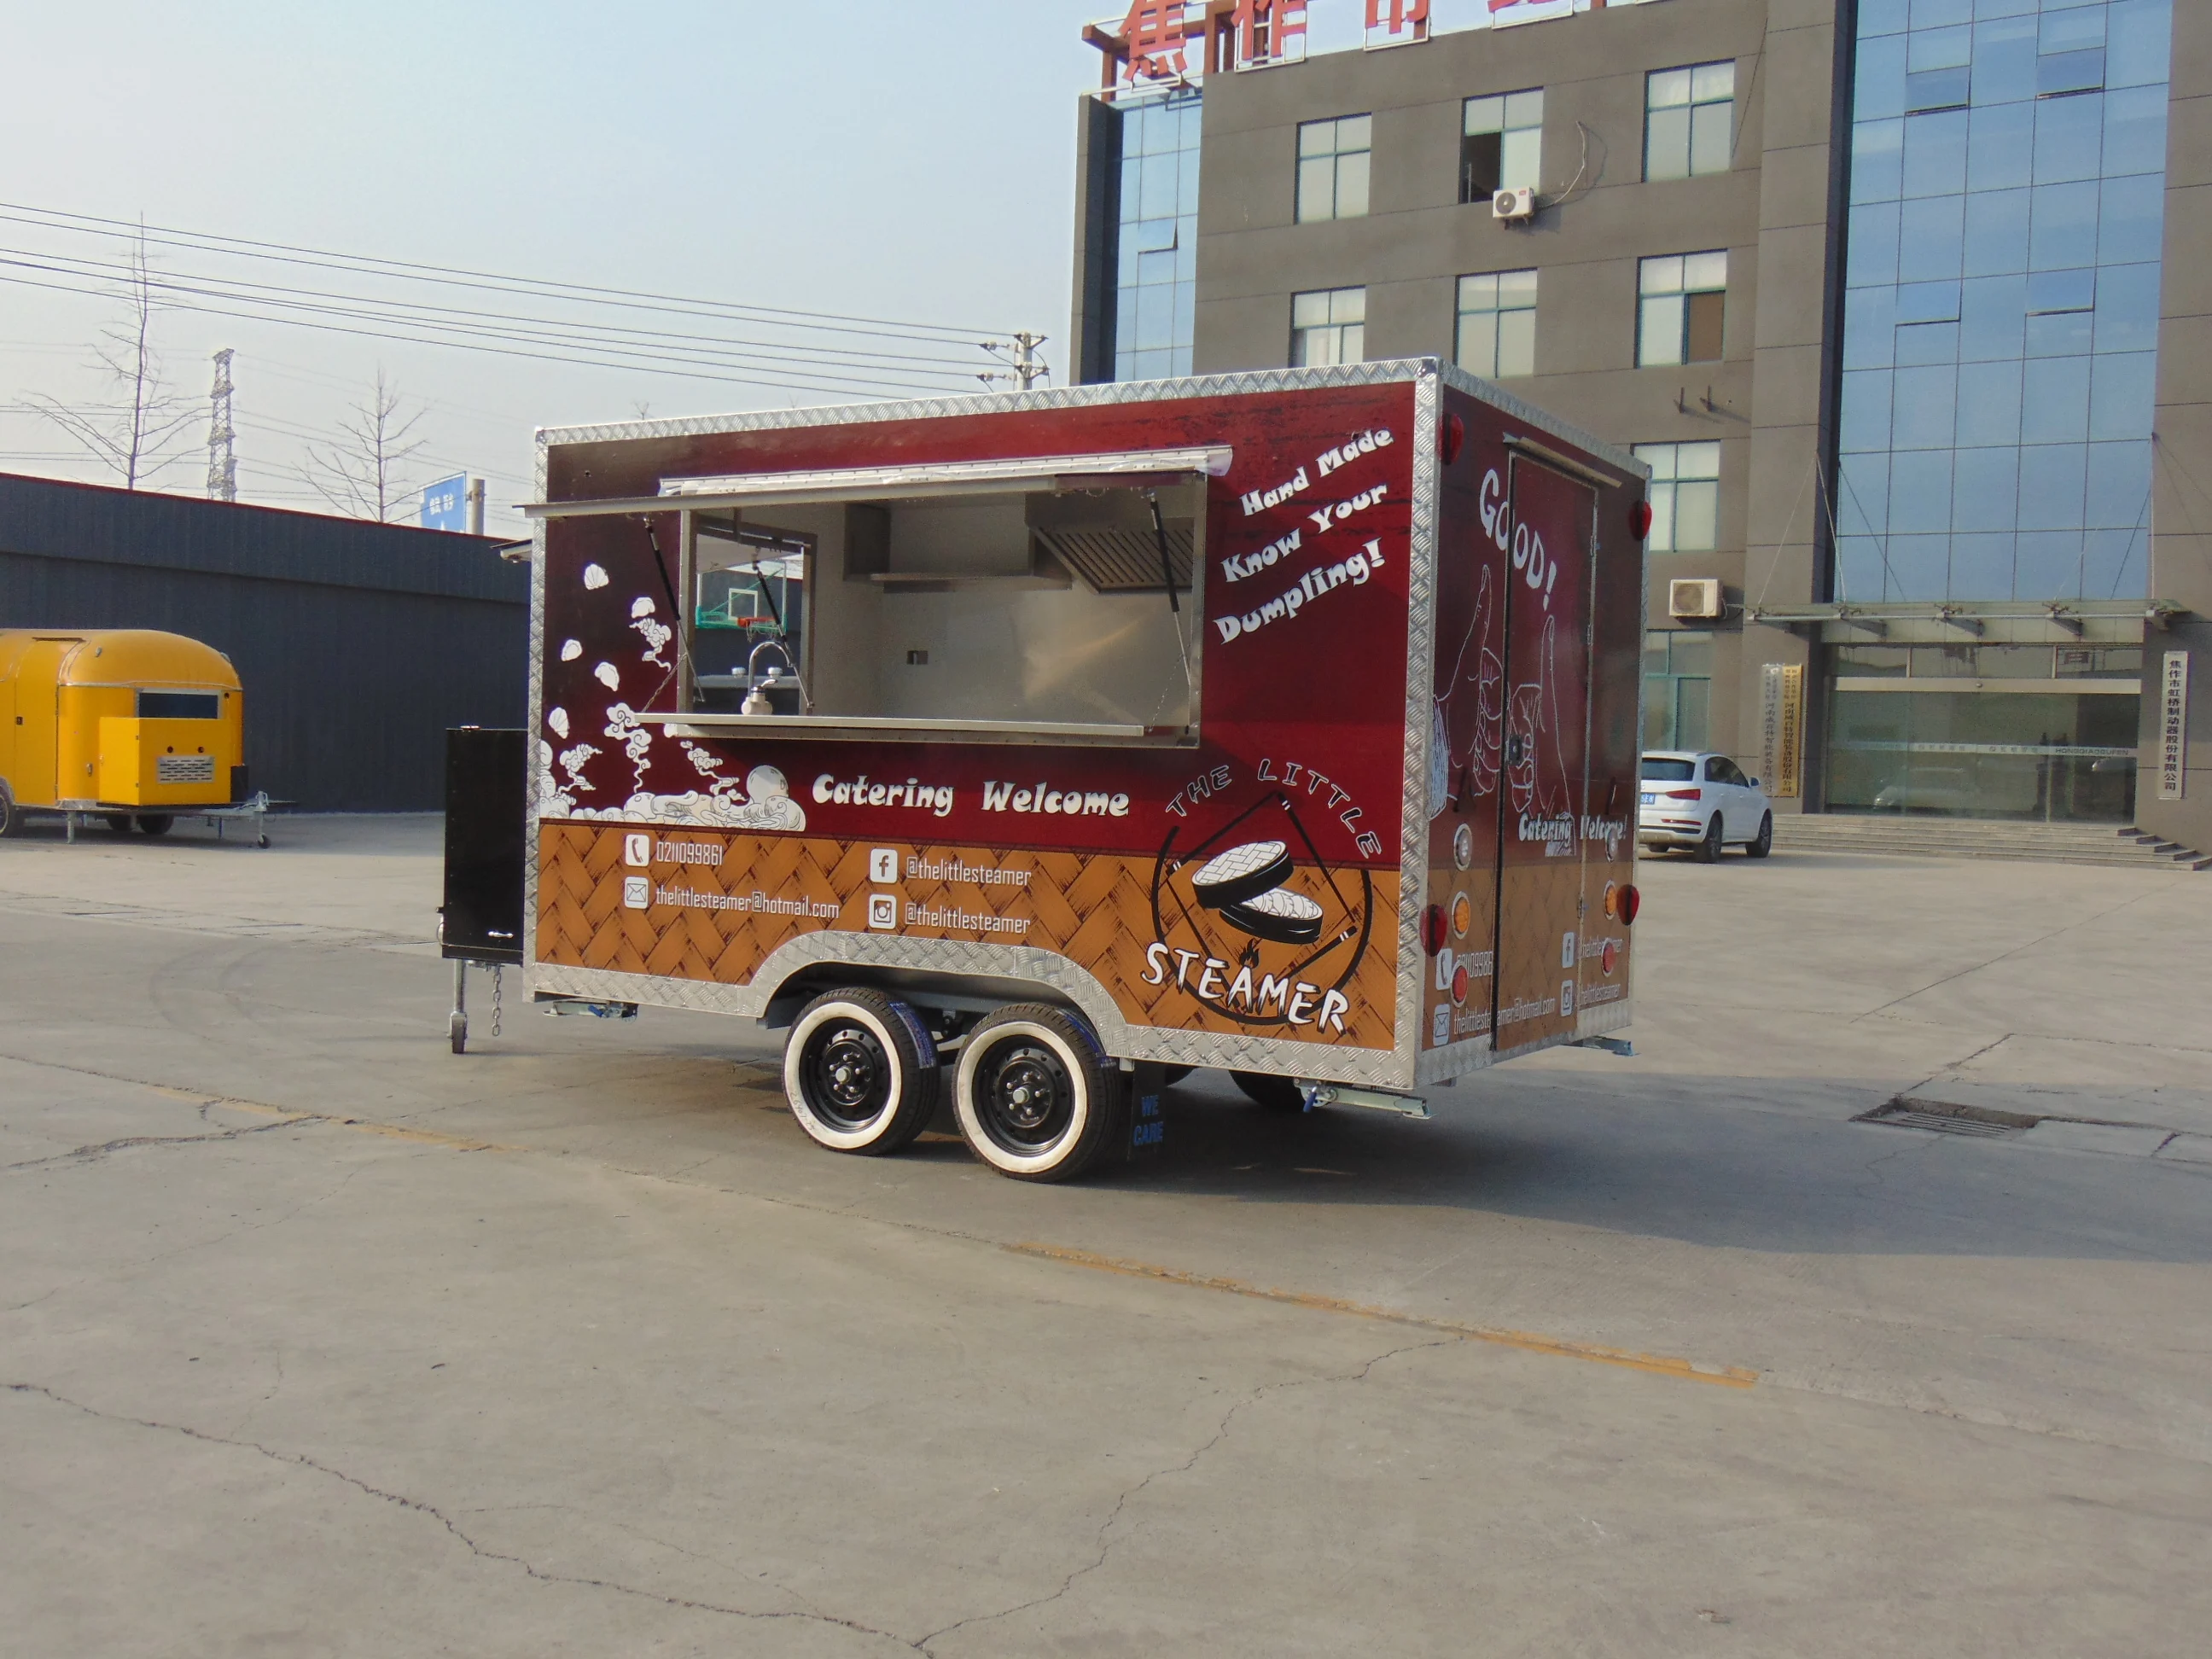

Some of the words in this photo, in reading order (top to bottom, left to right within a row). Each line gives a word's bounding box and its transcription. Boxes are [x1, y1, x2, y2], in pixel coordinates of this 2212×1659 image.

[1239, 466, 1310, 516] Hand
[1315, 428, 1394, 477] Made
[1220, 527, 1302, 582] Know
[1307, 484, 1388, 533] Your
[1480, 469, 1557, 611] GOOD!
[1213, 537, 1386, 645] Dumpling!
[812, 773, 955, 818] Catering
[981, 780, 1130, 817] Welcome
[1166, 765, 1233, 818] THE
[1257, 759, 1382, 859] LITTLE
[1519, 812, 1572, 847] Catering
[656, 841, 723, 866] 0211099861
[905, 856, 1033, 887] @thelittlesteamer
[655, 883, 841, 920] thelittlesteamer@hotmail.com
[905, 902, 1032, 934] @thelittlesteamer
[1140, 941, 1350, 1037] STEAMER
[1141, 1094, 1159, 1117] WE
[1133, 1121, 1164, 1146] CARE
